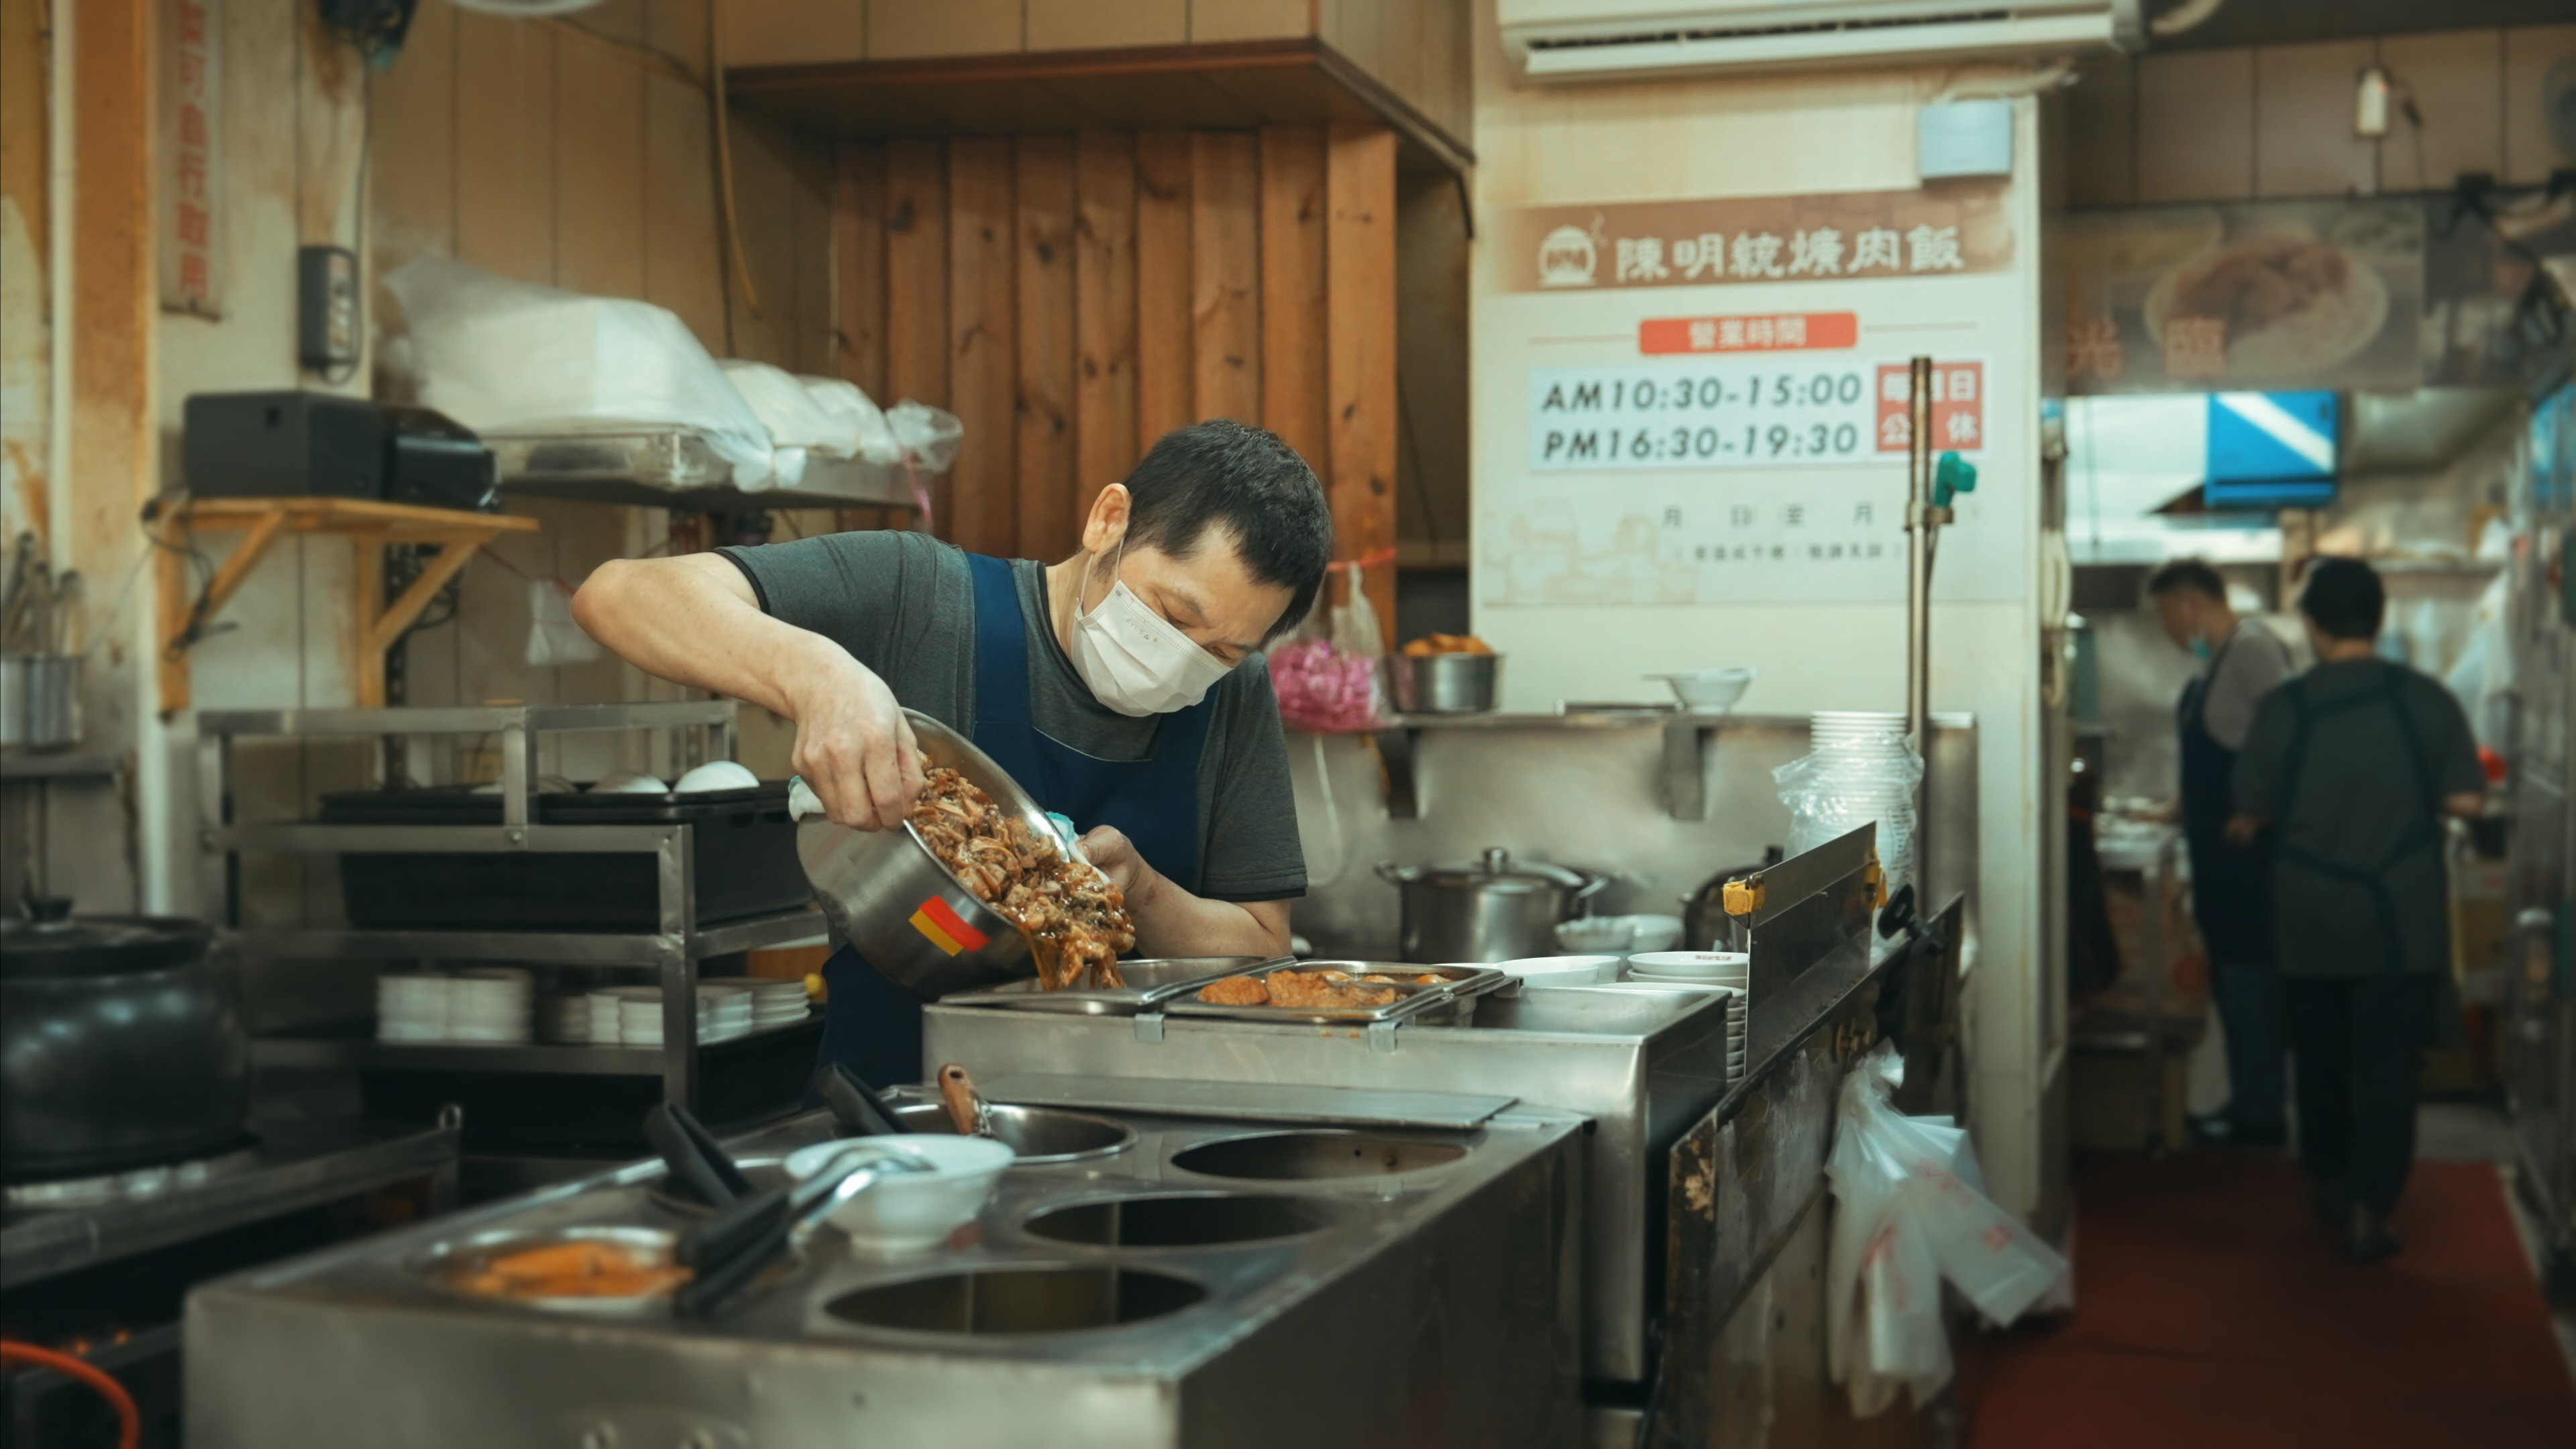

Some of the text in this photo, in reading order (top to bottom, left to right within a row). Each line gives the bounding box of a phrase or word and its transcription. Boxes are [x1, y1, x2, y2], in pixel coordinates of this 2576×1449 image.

[1615, 223, 1965, 284] 陳明統爌肉飯
[1689, 317, 1807, 350] 營業時間
